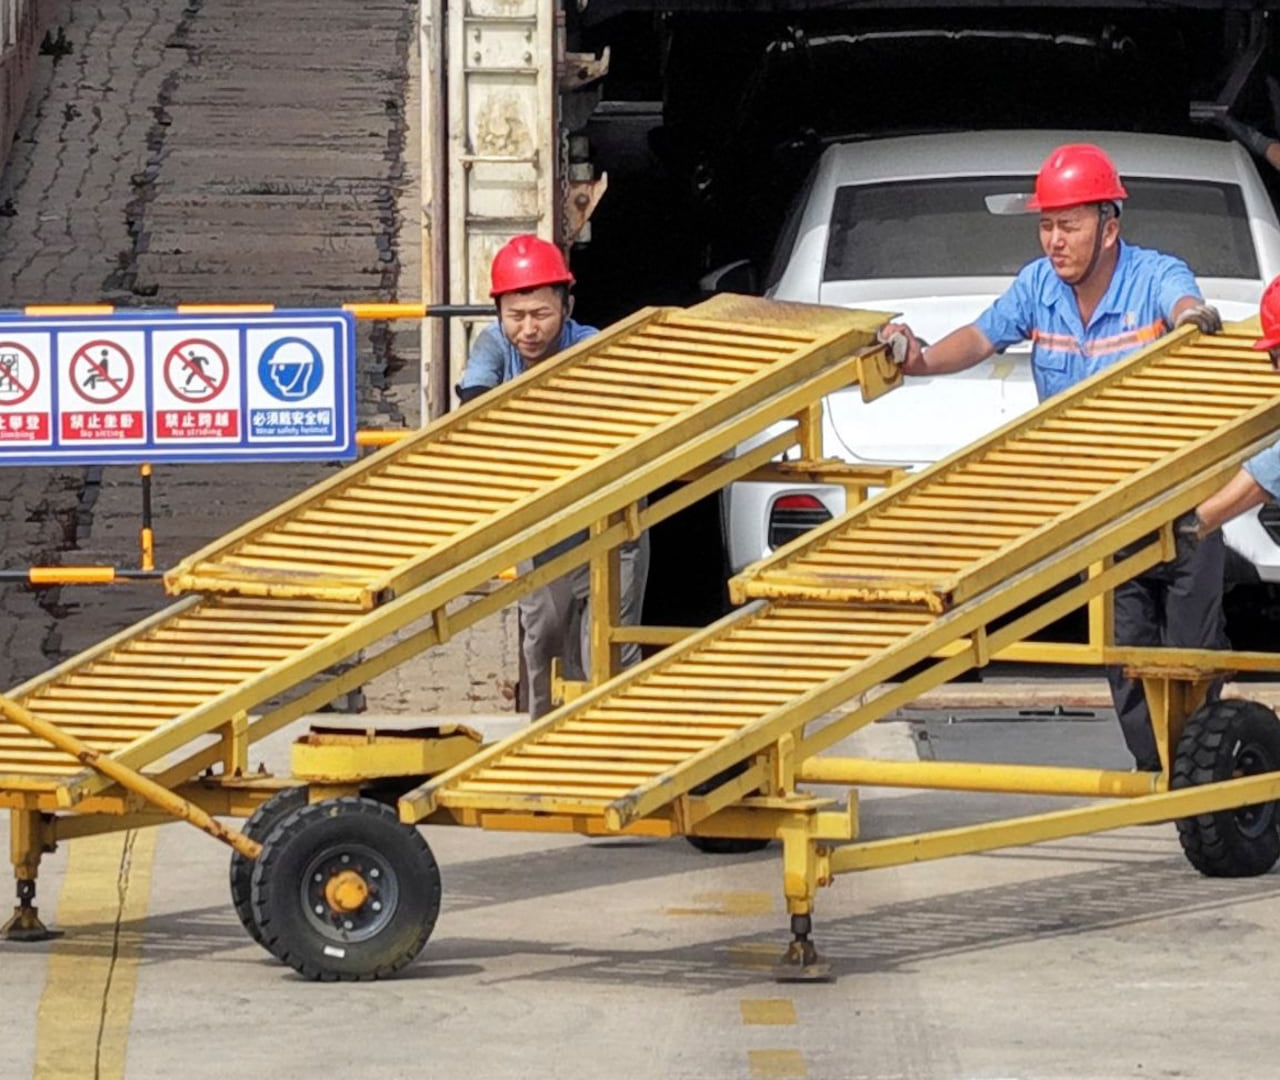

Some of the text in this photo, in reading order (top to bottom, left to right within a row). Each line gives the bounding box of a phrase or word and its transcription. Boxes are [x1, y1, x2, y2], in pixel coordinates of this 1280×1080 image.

[253, 411, 330, 426] 必须戴安全帽
[95, 429, 125, 439] sitting
[186, 427, 222, 437] striding
